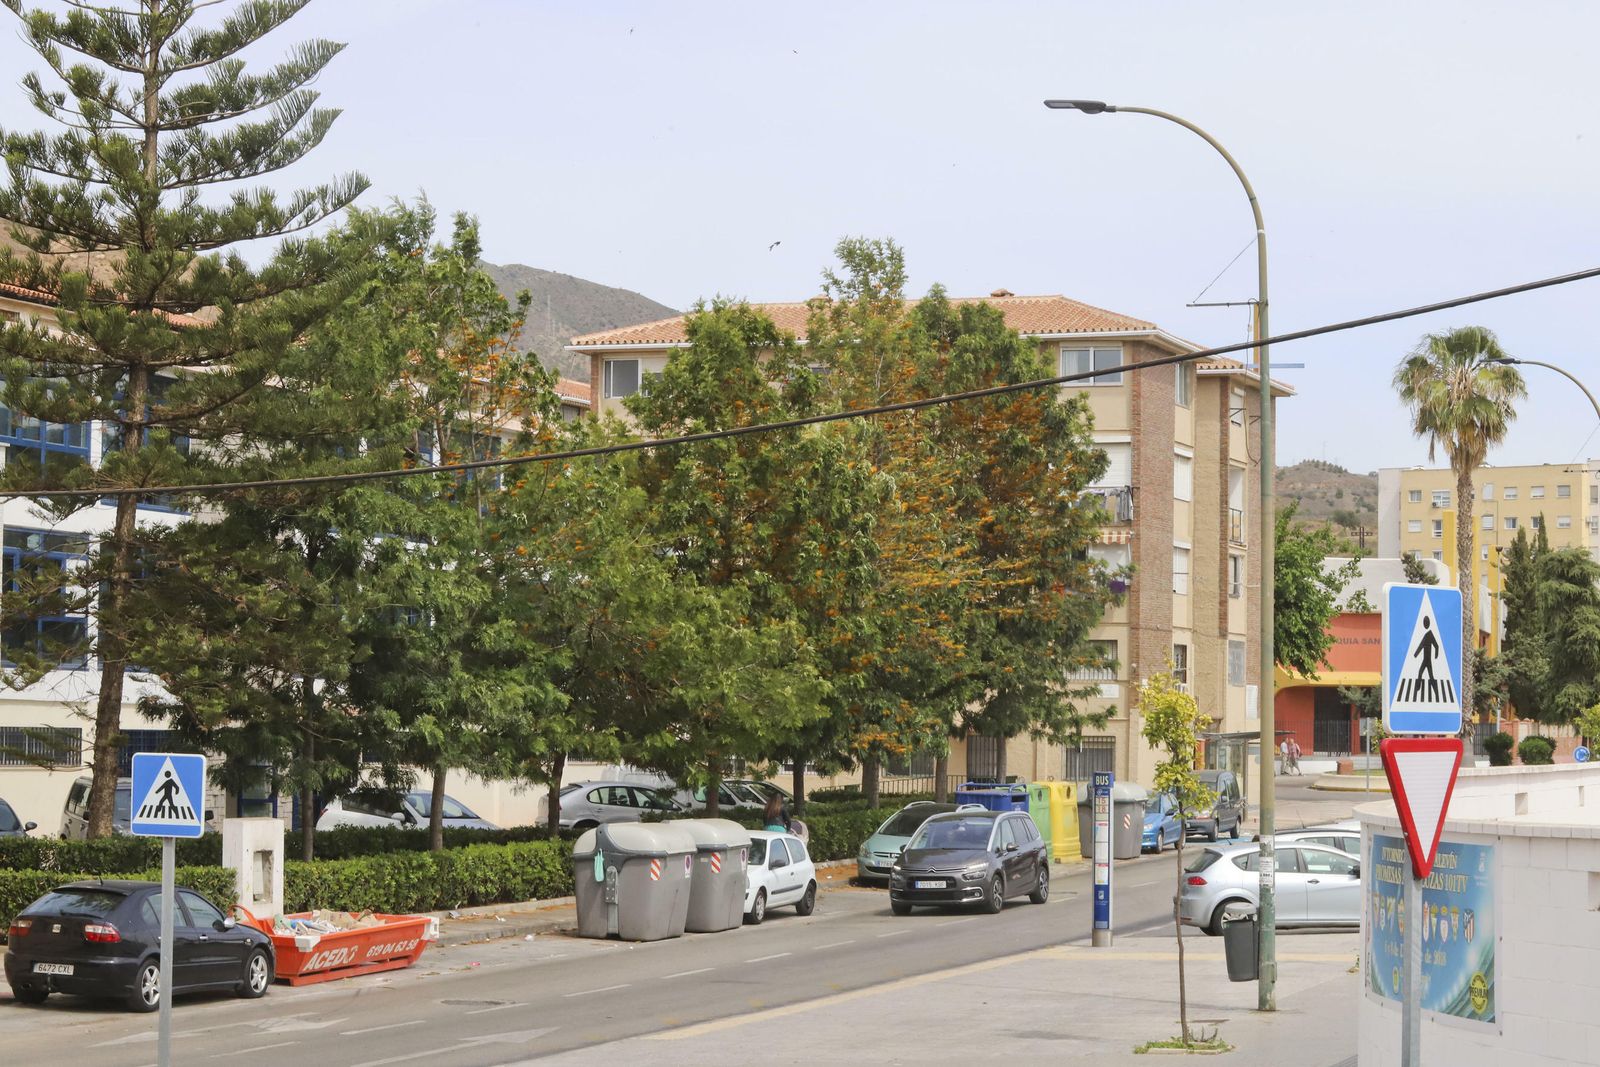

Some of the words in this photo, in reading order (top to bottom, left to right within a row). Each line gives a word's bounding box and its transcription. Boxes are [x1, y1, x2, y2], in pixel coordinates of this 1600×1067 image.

[1337, 637, 1359, 645] QUIA
[1361, 637, 1380, 645] SAN
[1095, 775, 1109, 786] BUS
[38, 963, 57, 973] 6472
